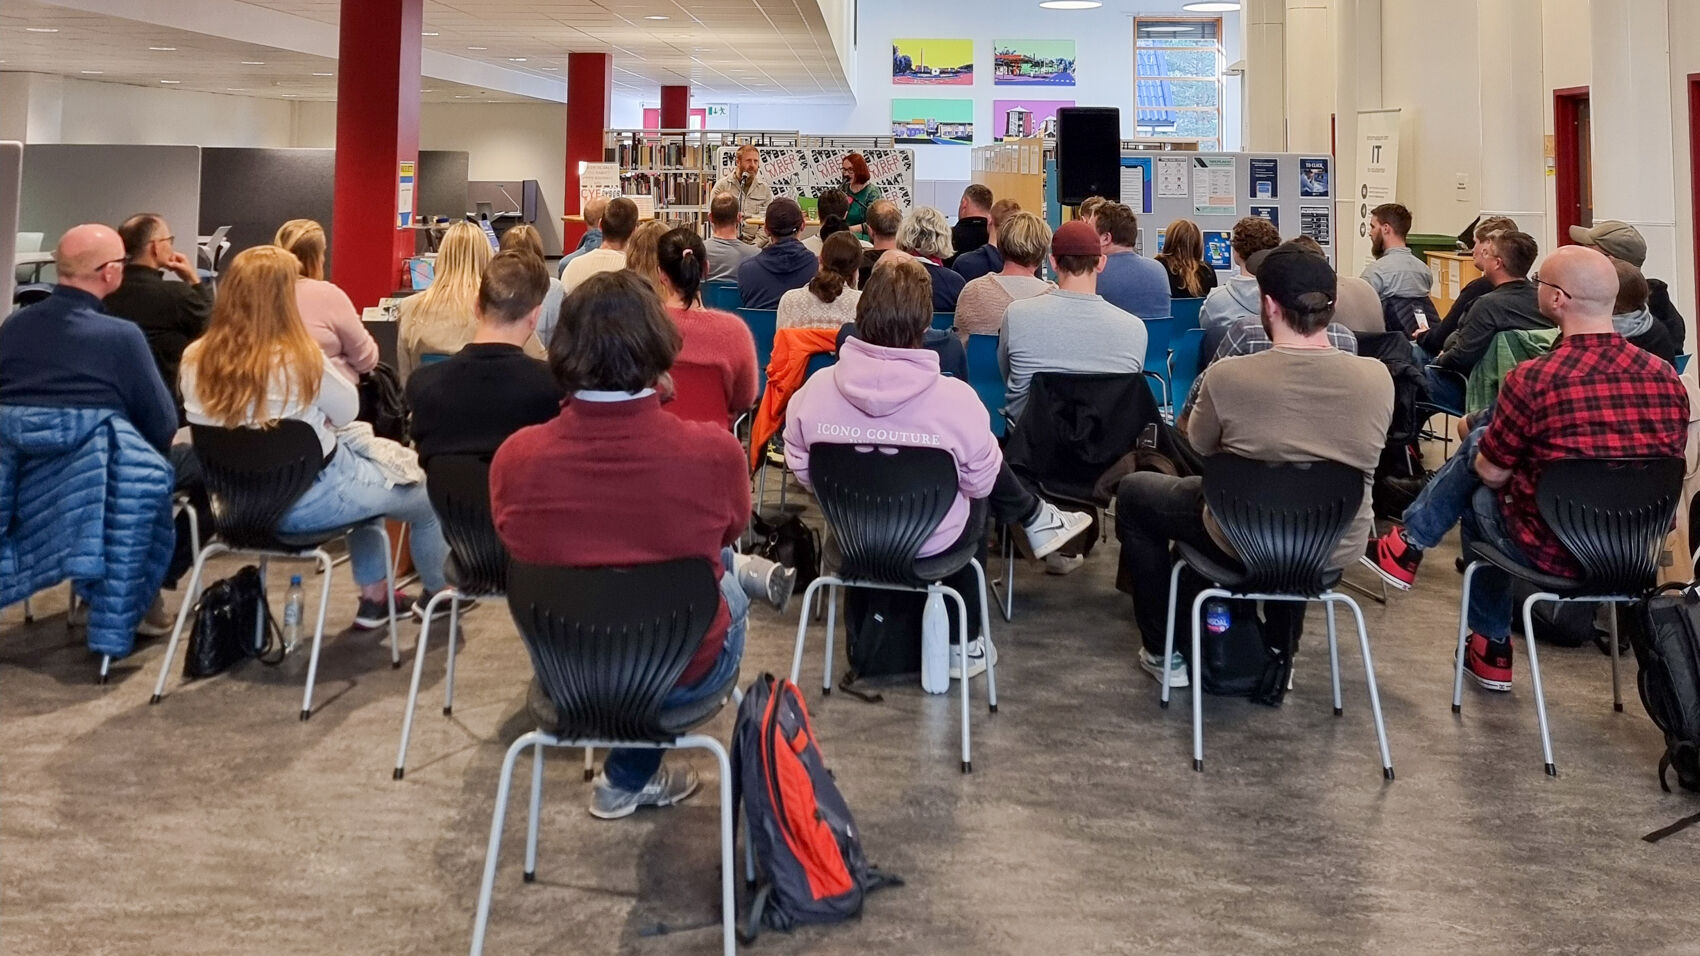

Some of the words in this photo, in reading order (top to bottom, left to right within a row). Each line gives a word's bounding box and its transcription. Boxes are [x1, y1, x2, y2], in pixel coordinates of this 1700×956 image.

[764, 154, 796, 173] CYBER
[868, 154, 899, 173] CYBER
[1371, 145, 1382, 164] IT
[768, 161, 795, 179] MART
[873, 161, 899, 179] MART
[817, 423, 861, 438] ICONO
[866, 428, 940, 446] COUTURE
